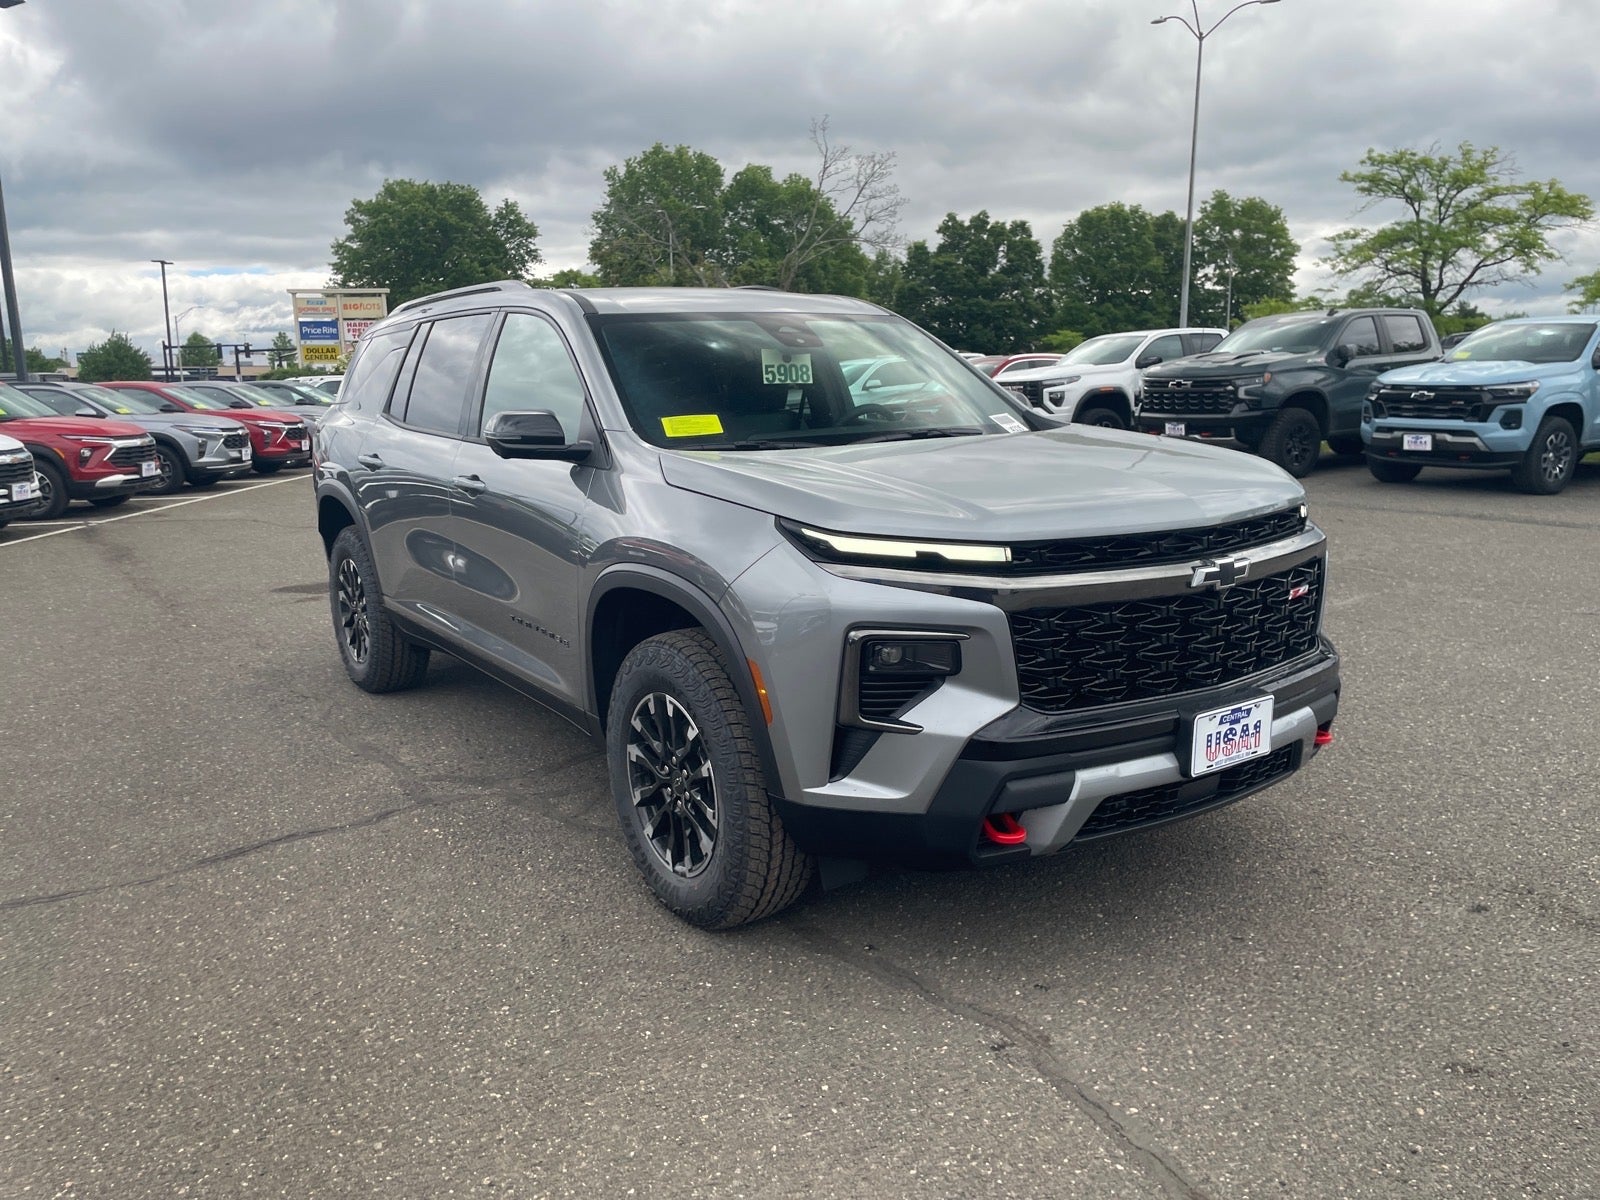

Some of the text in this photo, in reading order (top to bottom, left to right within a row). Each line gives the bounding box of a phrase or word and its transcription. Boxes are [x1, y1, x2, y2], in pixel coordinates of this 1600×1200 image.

[302, 326, 338, 334] Price Rite
[764, 363, 811, 384] 5908
[1222, 710, 1249, 723] CENTRAL
